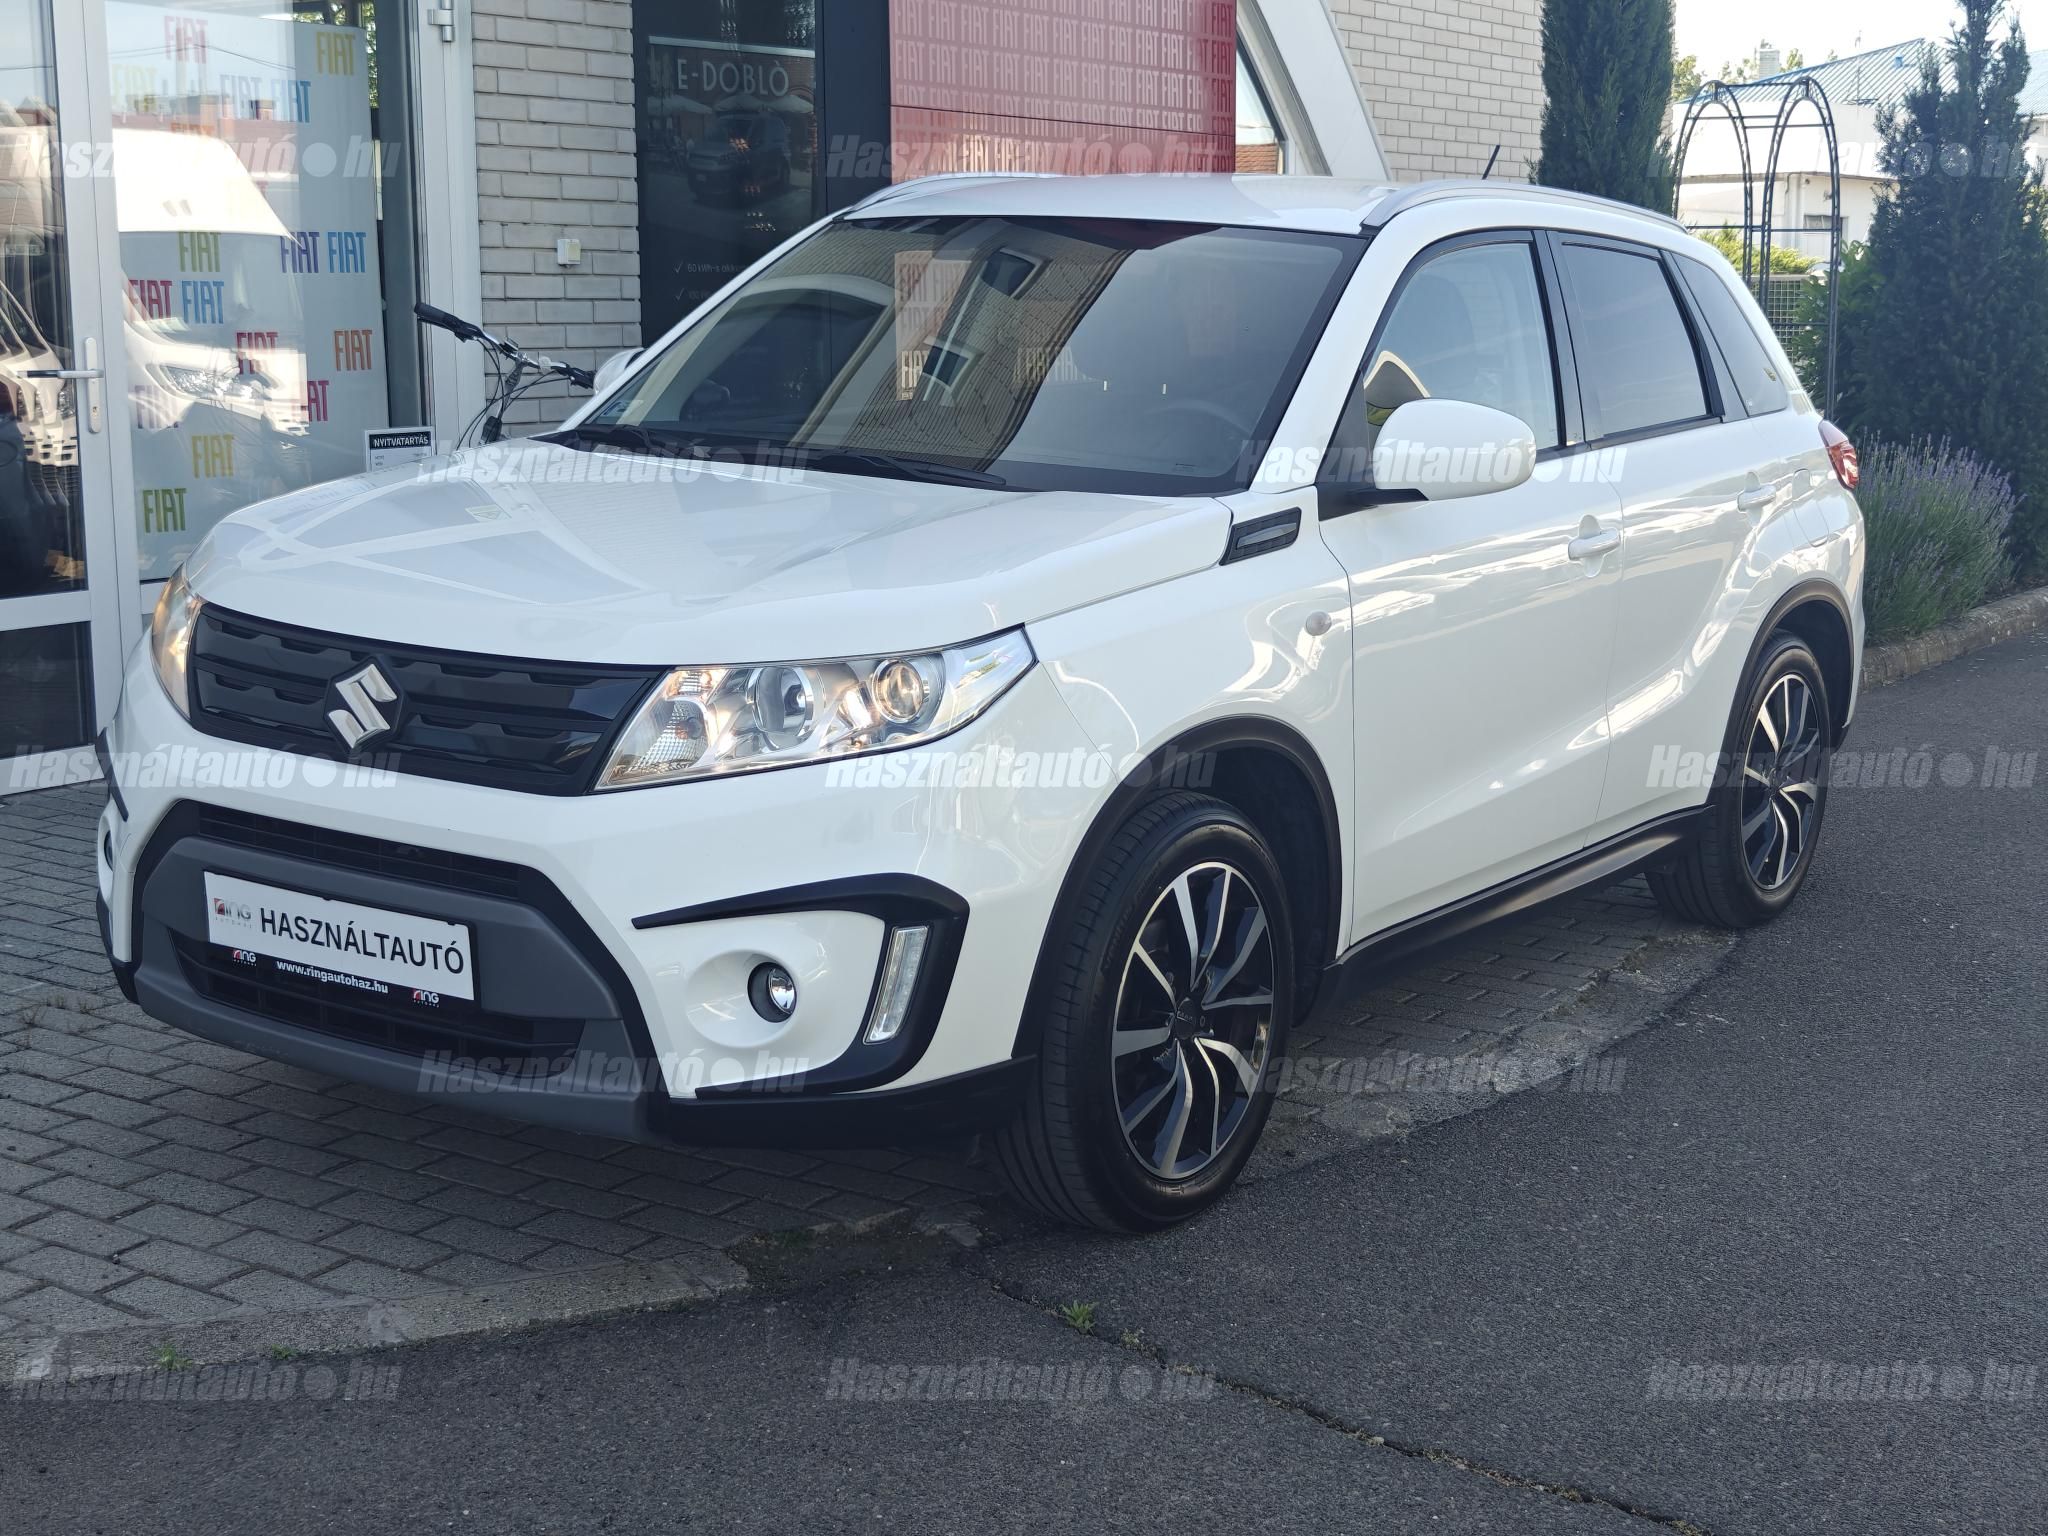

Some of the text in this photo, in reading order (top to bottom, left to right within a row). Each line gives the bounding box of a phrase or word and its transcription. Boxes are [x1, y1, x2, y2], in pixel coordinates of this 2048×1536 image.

[164, 15, 208, 64] FIAT
[316, 31, 356, 76] FIAT
[895, 0, 925, 36] FIAT
[928, 0, 957, 40] FIAT
[961, 4, 989, 45] FIAT
[993, 8, 1020, 48] FIAT
[1024, 13, 1049, 52] FIAT
[1053, 17, 1078, 56] FIAT
[1081, 21, 1106, 59] FIAT
[1109, 25, 1133, 63] FIAT
[1136, 29, 1159, 66] FIAT
[1161, 32, 1184, 69] FIAT
[1211, 39, 1232, 75] FIAT
[895, 39, 925, 81] FIAT
[928, 44, 957, 84] FIAT
[961, 48, 989, 88] FIAT
[993, 51, 1020, 91] FIAT
[1024, 55, 1049, 94] FIAT
[1053, 58, 1078, 98] FIAT
[1081, 62, 1106, 101] FIAT
[1109, 65, 1133, 103] FIAT
[1136, 69, 1159, 106] FIAT
[1161, 72, 1184, 108] FIAT
[1211, 78, 1232, 112] FIAT
[270, 79, 311, 123] FIAT
[179, 231, 221, 272] FIAT
[281, 231, 366, 273] FIAT FIAT
[181, 280, 224, 324] FIAT
[334, 329, 372, 371] FIAT
[191, 434, 234, 478] FIAT
[374, 435, 429, 448] NYITVATARTÁS
[142, 487, 187, 533] FIAT
[260, 907, 465, 974] HASZNÁLTAUTÓ
[276, 960, 389, 994] www.ringautohaz.hu
